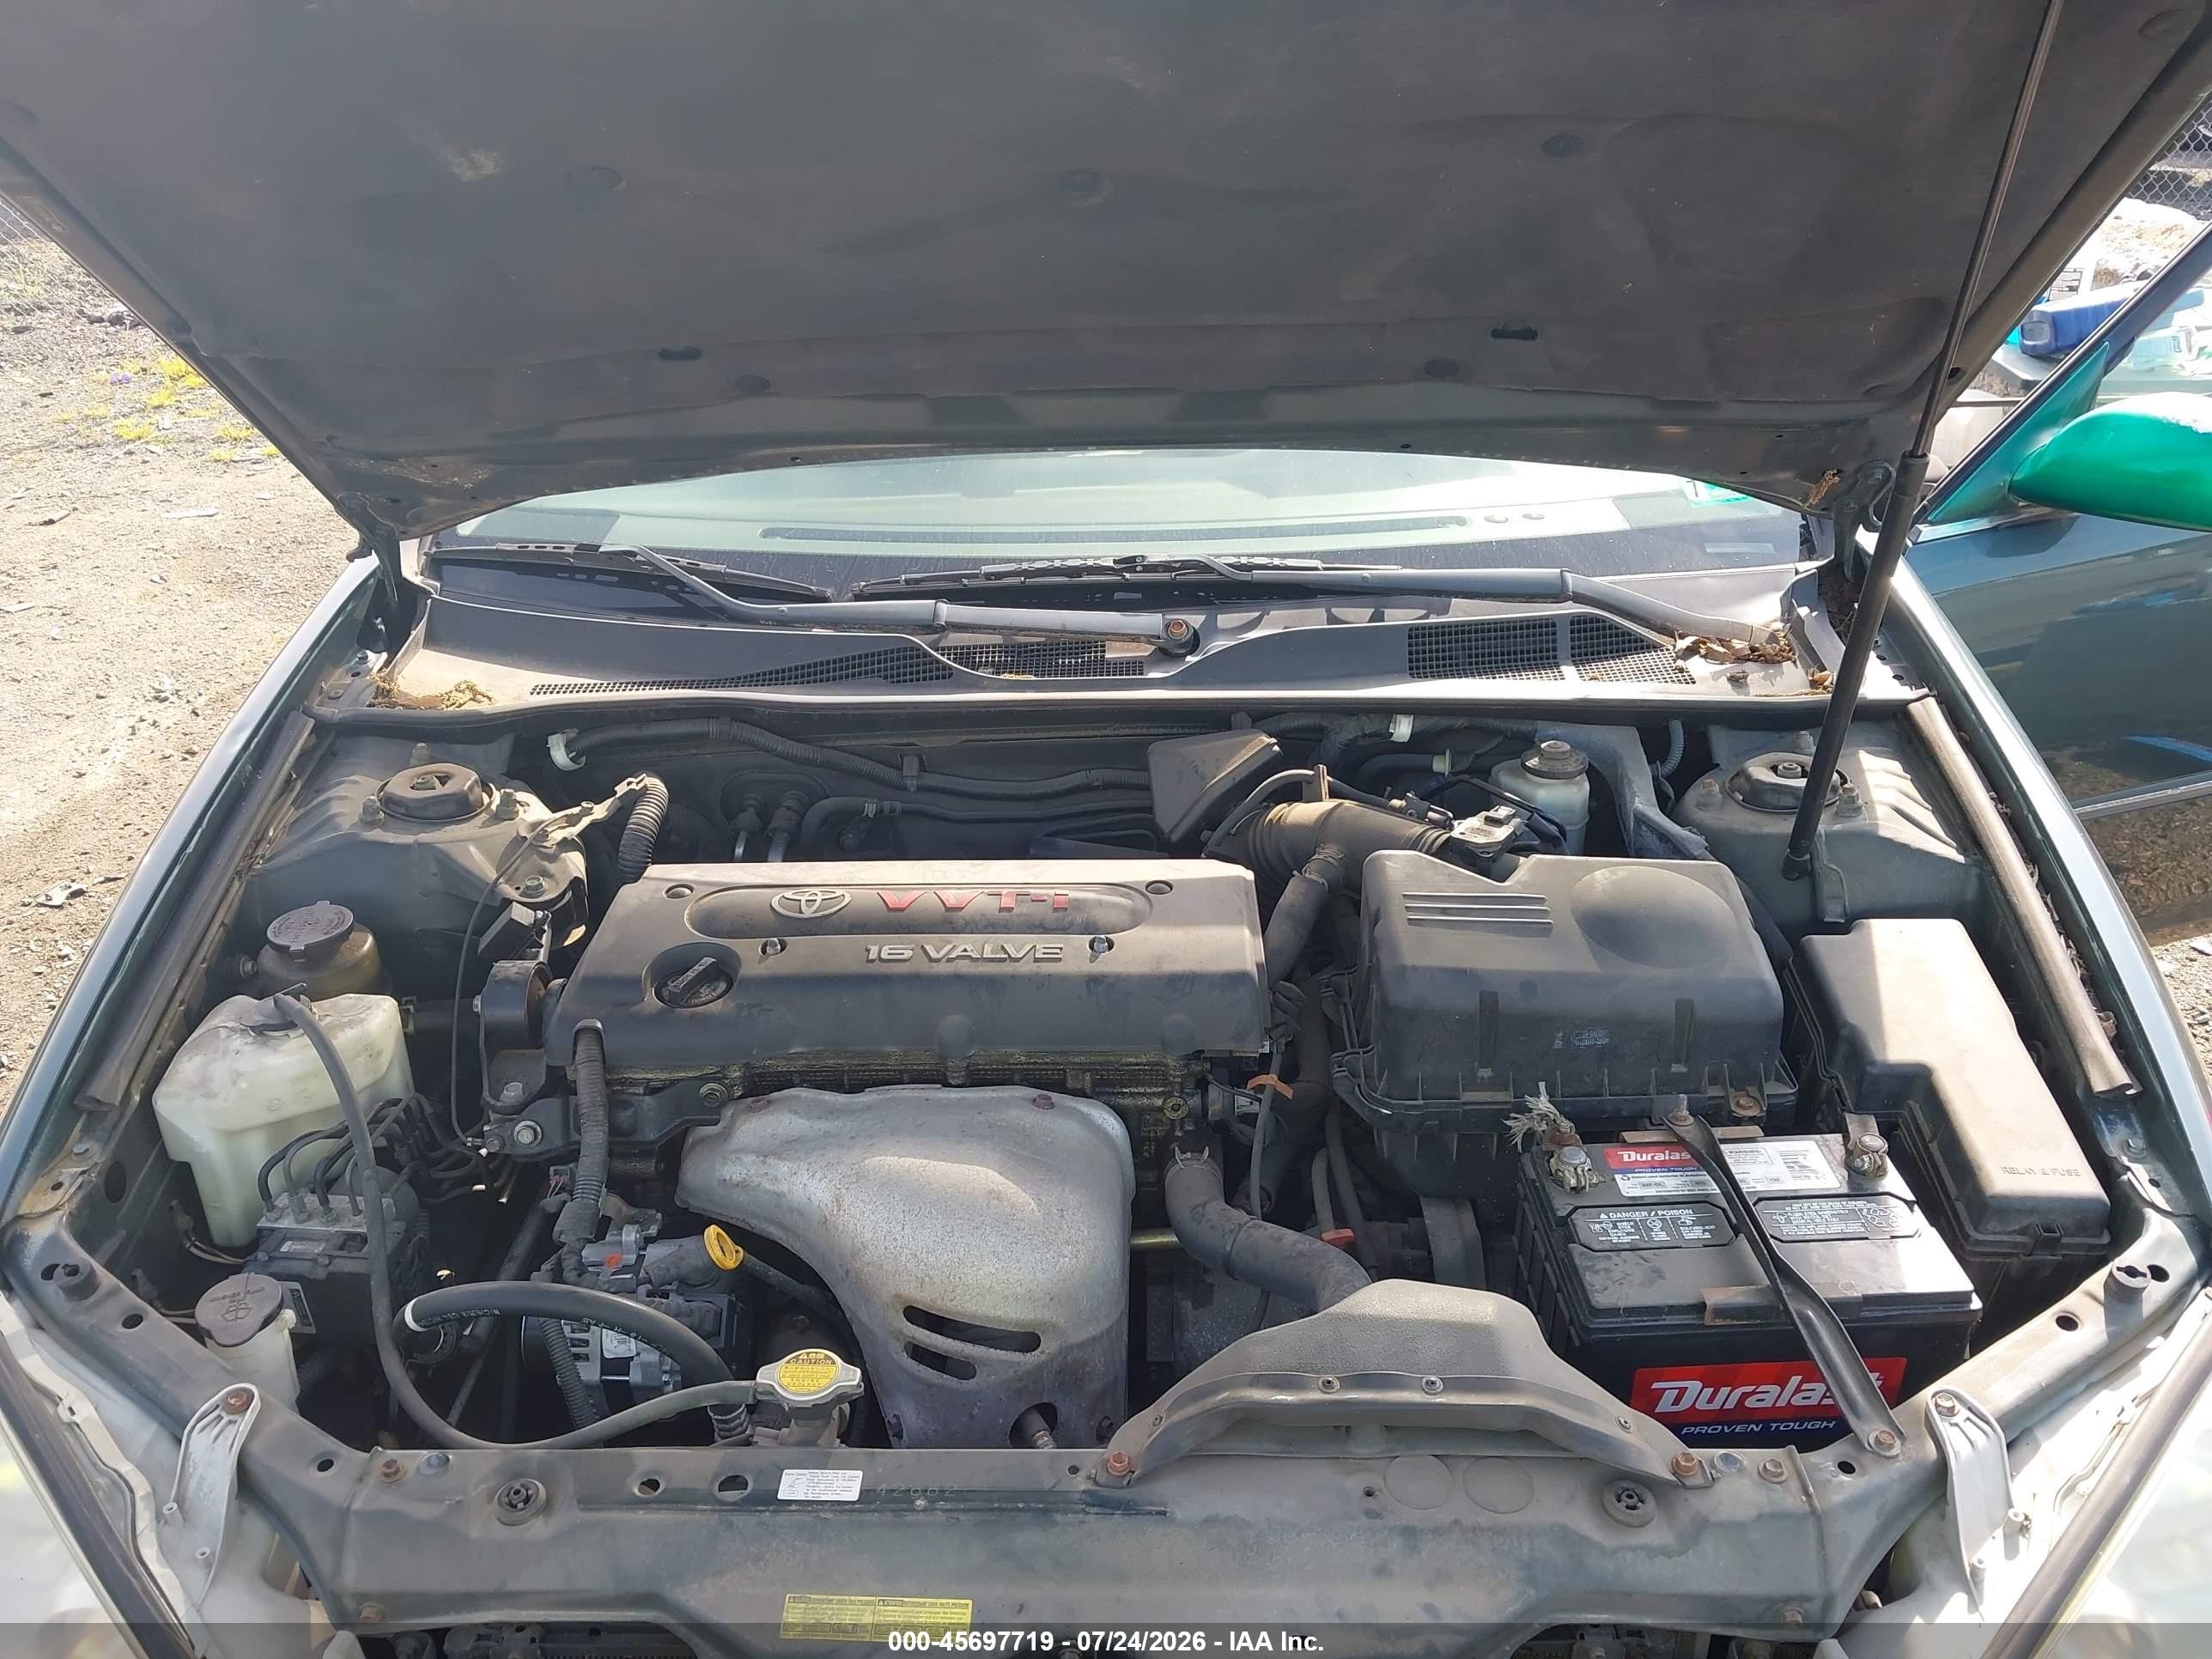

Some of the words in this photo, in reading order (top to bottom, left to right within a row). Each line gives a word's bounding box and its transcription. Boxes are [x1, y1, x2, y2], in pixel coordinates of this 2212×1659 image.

[866, 944, 915, 963] 16
[921, 944, 1064, 963] VALVE
[1617, 1150, 1692, 1162] Duralas
[2001, 1166, 2036, 1176] RELAY
[2051, 1168, 2081, 1177] FUSE
[1650, 1373, 1883, 1413] Durala
[1680, 1422, 1764, 1435] PROVEN
[1769, 1419, 1838, 1432] TOUGH
